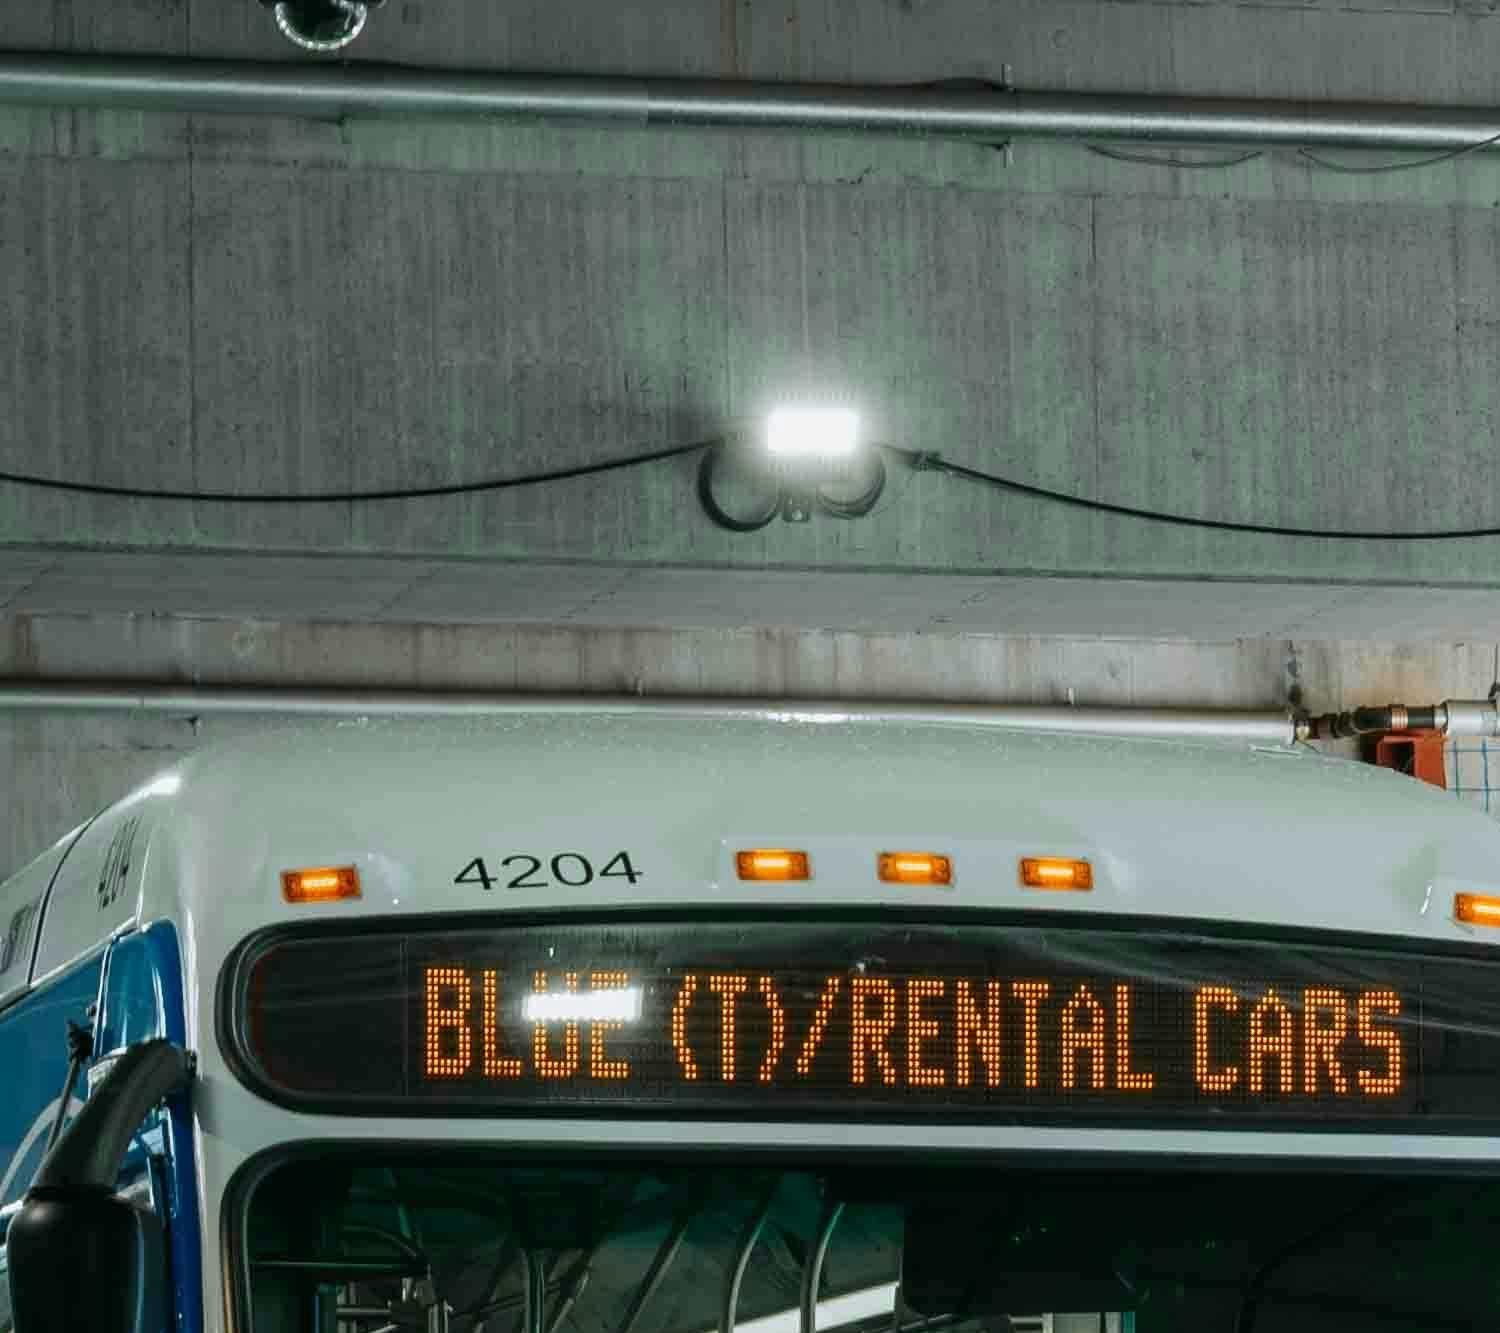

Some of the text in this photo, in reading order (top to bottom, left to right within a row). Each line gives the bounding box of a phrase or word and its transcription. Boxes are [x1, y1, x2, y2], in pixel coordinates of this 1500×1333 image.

[453, 851, 643, 890] 4204
[425, 968, 1402, 1096] BLUE (T)/RENTAL CARS
